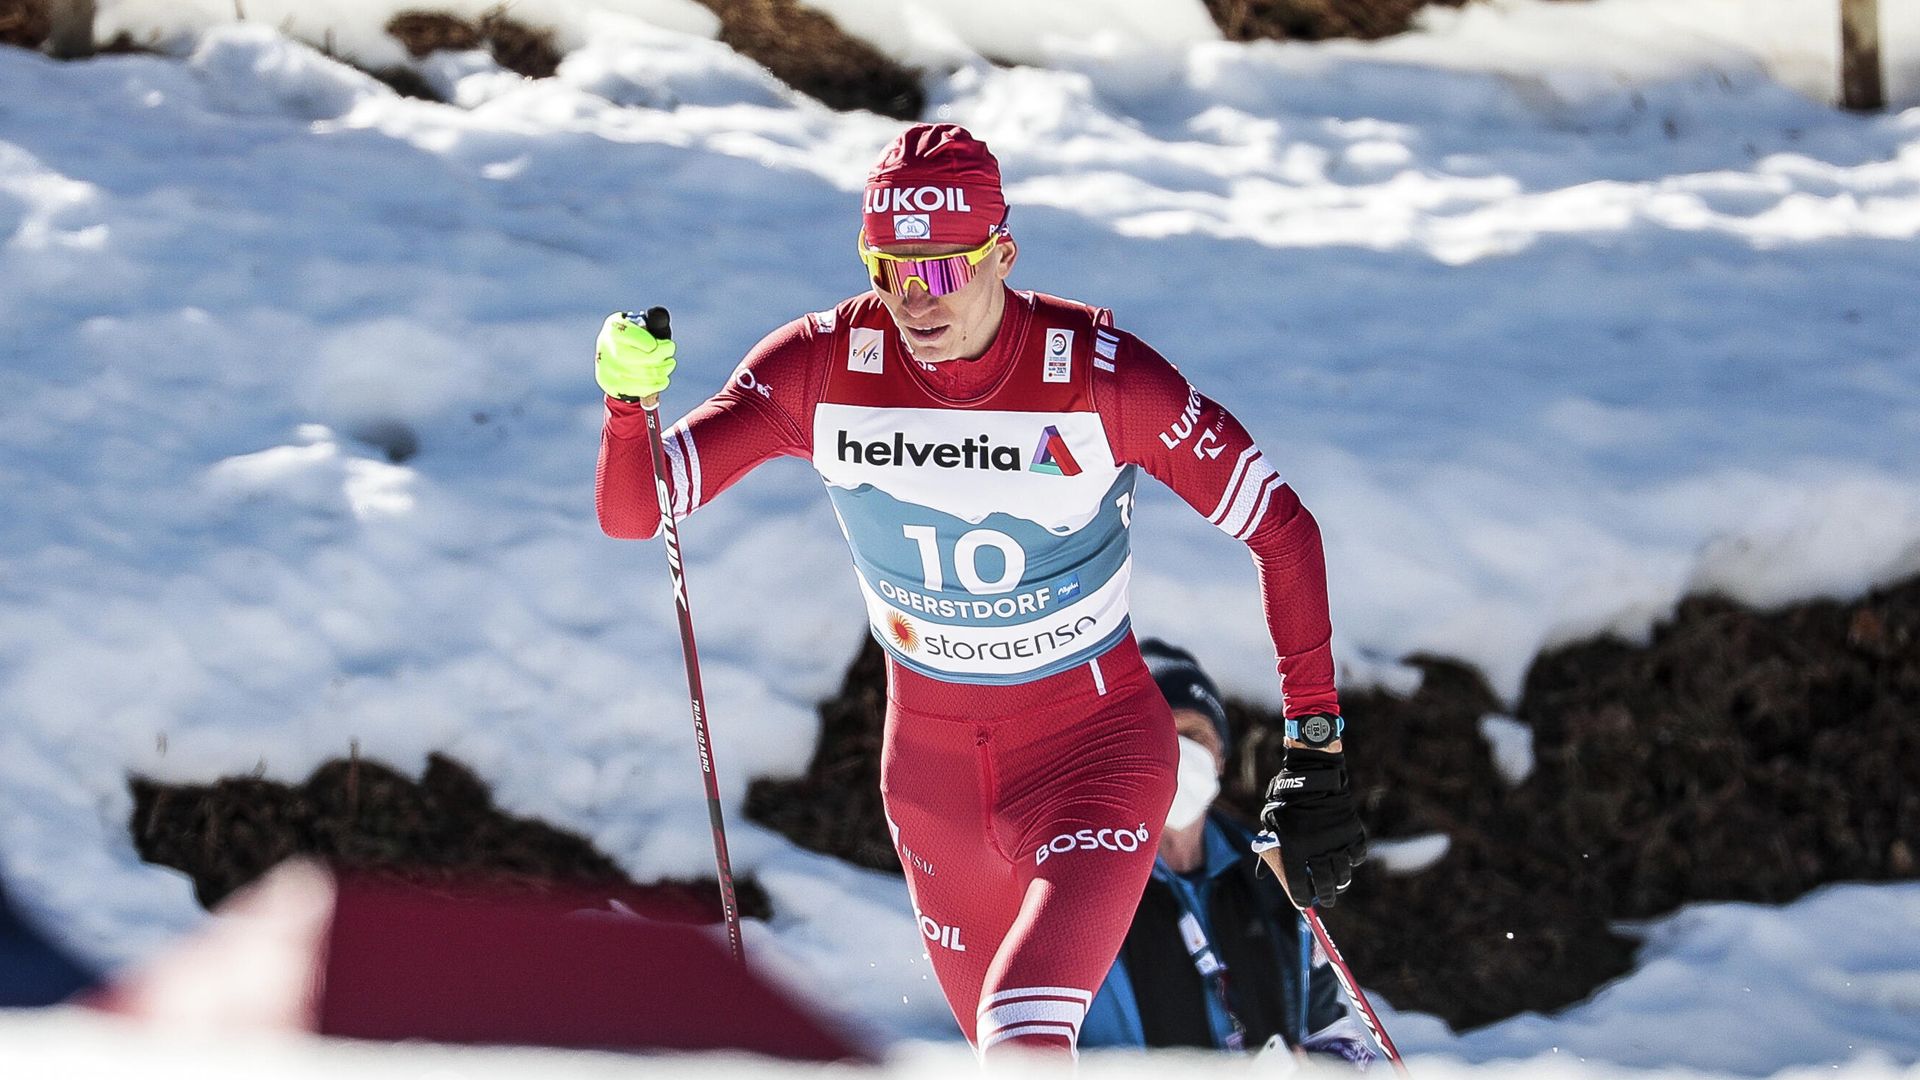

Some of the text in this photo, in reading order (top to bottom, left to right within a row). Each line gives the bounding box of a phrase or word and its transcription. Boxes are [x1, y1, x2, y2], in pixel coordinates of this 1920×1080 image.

[865, 186, 971, 213] LUKOIL
[1158, 386, 1201, 450] LUKO
[838, 430, 1021, 472] helvetia
[902, 524, 1026, 595] 10
[879, 580, 1051, 619] OBERSTDORF
[1036, 828, 1139, 866] BOSCO
